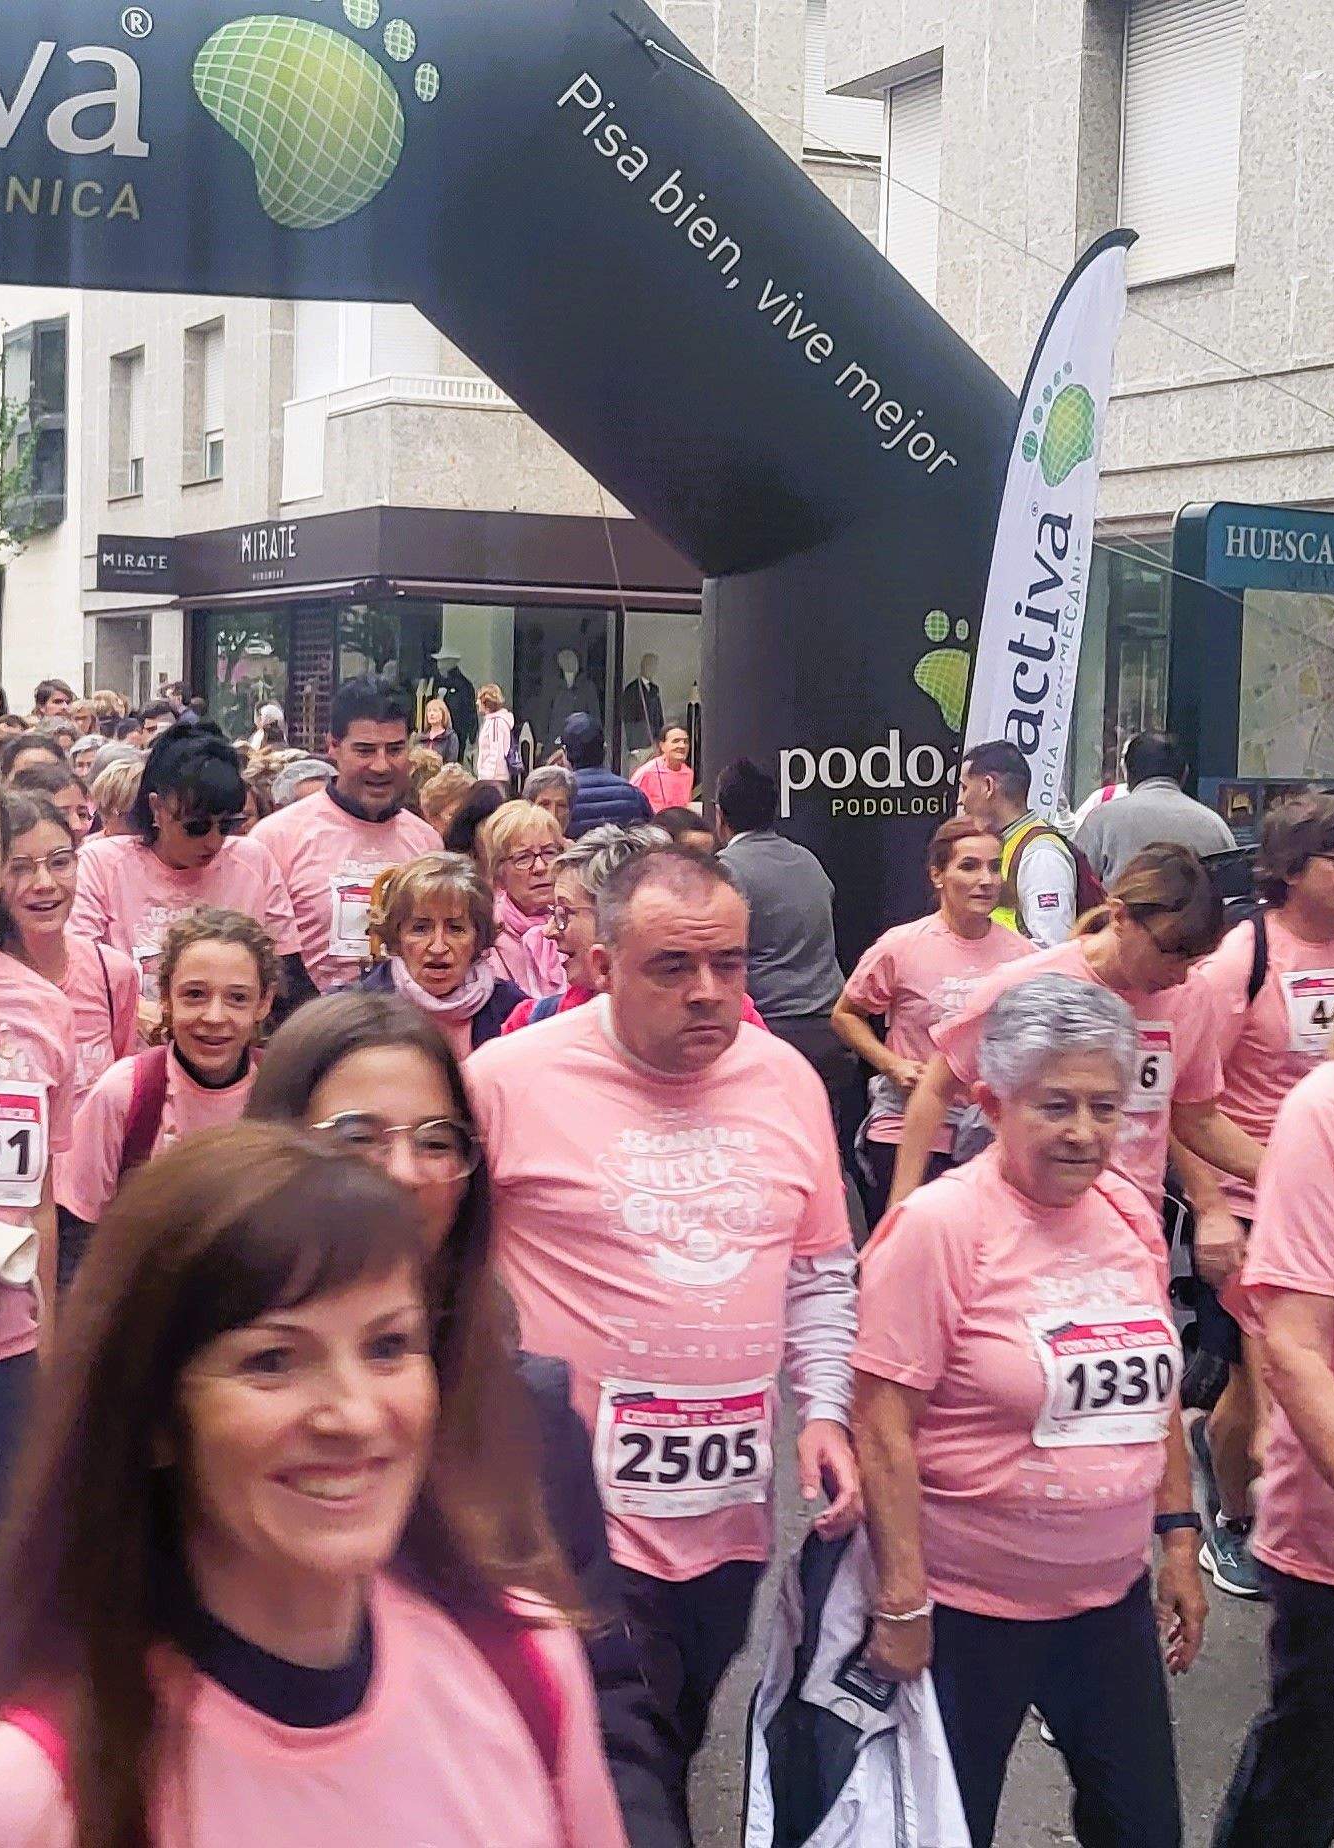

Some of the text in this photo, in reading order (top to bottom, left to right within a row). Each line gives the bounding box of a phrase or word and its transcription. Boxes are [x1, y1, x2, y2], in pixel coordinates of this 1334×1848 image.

[556, 72, 958, 475] Pisa bien, vive mejor
[102, 552, 168, 571] MIRATE
[241, 525, 298, 564] MIRATE
[779, 728, 960, 818] podo
[1066, 1353, 1173, 1411] 1330
[616, 1428, 758, 1484] 2505
